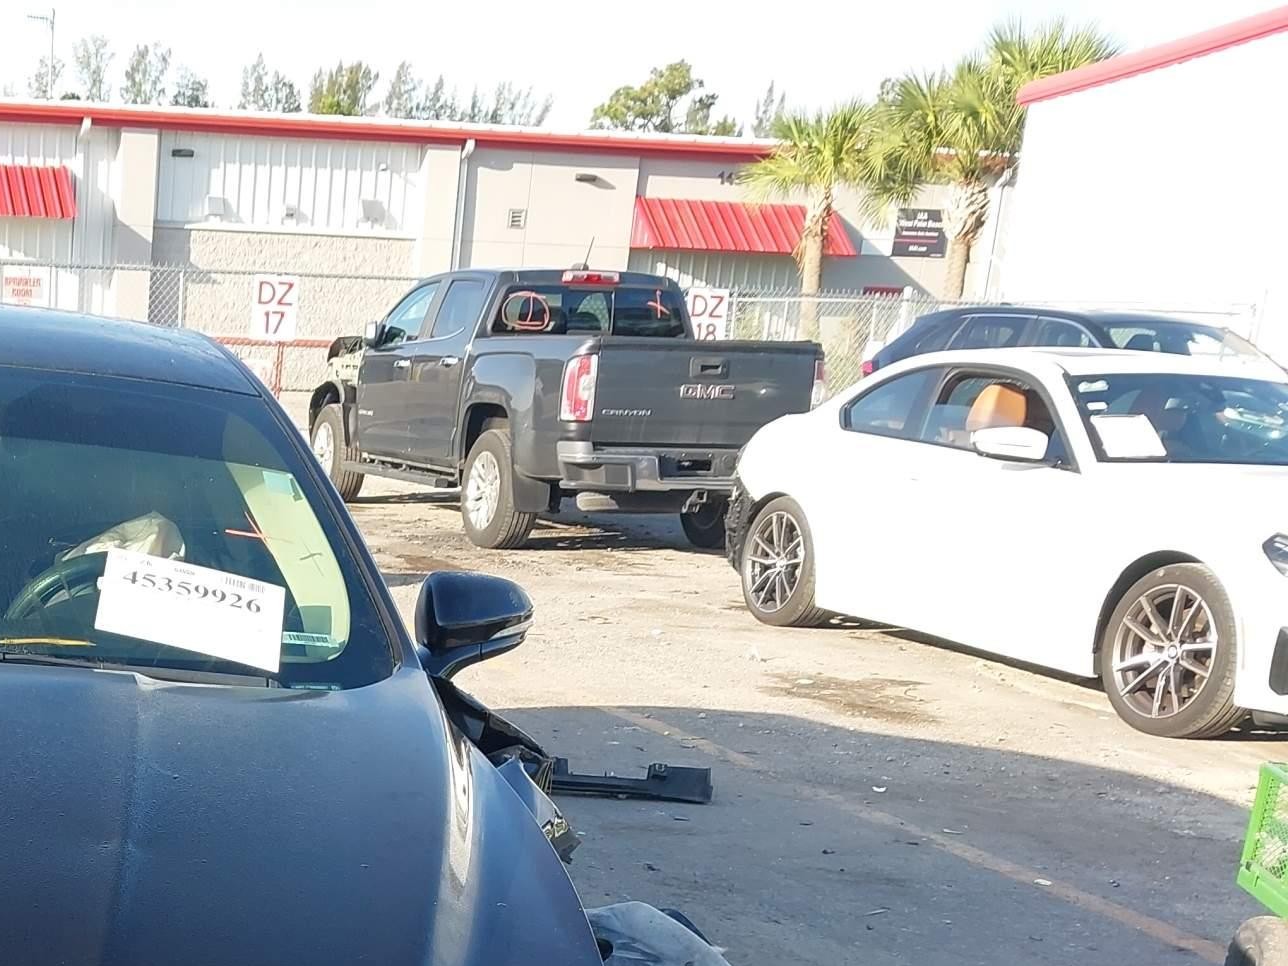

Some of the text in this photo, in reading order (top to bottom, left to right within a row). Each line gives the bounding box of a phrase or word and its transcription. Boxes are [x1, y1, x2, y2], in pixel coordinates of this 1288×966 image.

[257, 280, 294, 306] DZ
[691, 294, 725, 318] DZ
[264, 310, 285, 334] 17
[696, 322, 717, 341] 18
[679, 383, 736, 400] GMC
[601, 408, 652, 417] CANYON
[122, 570, 262, 614] 45359926
